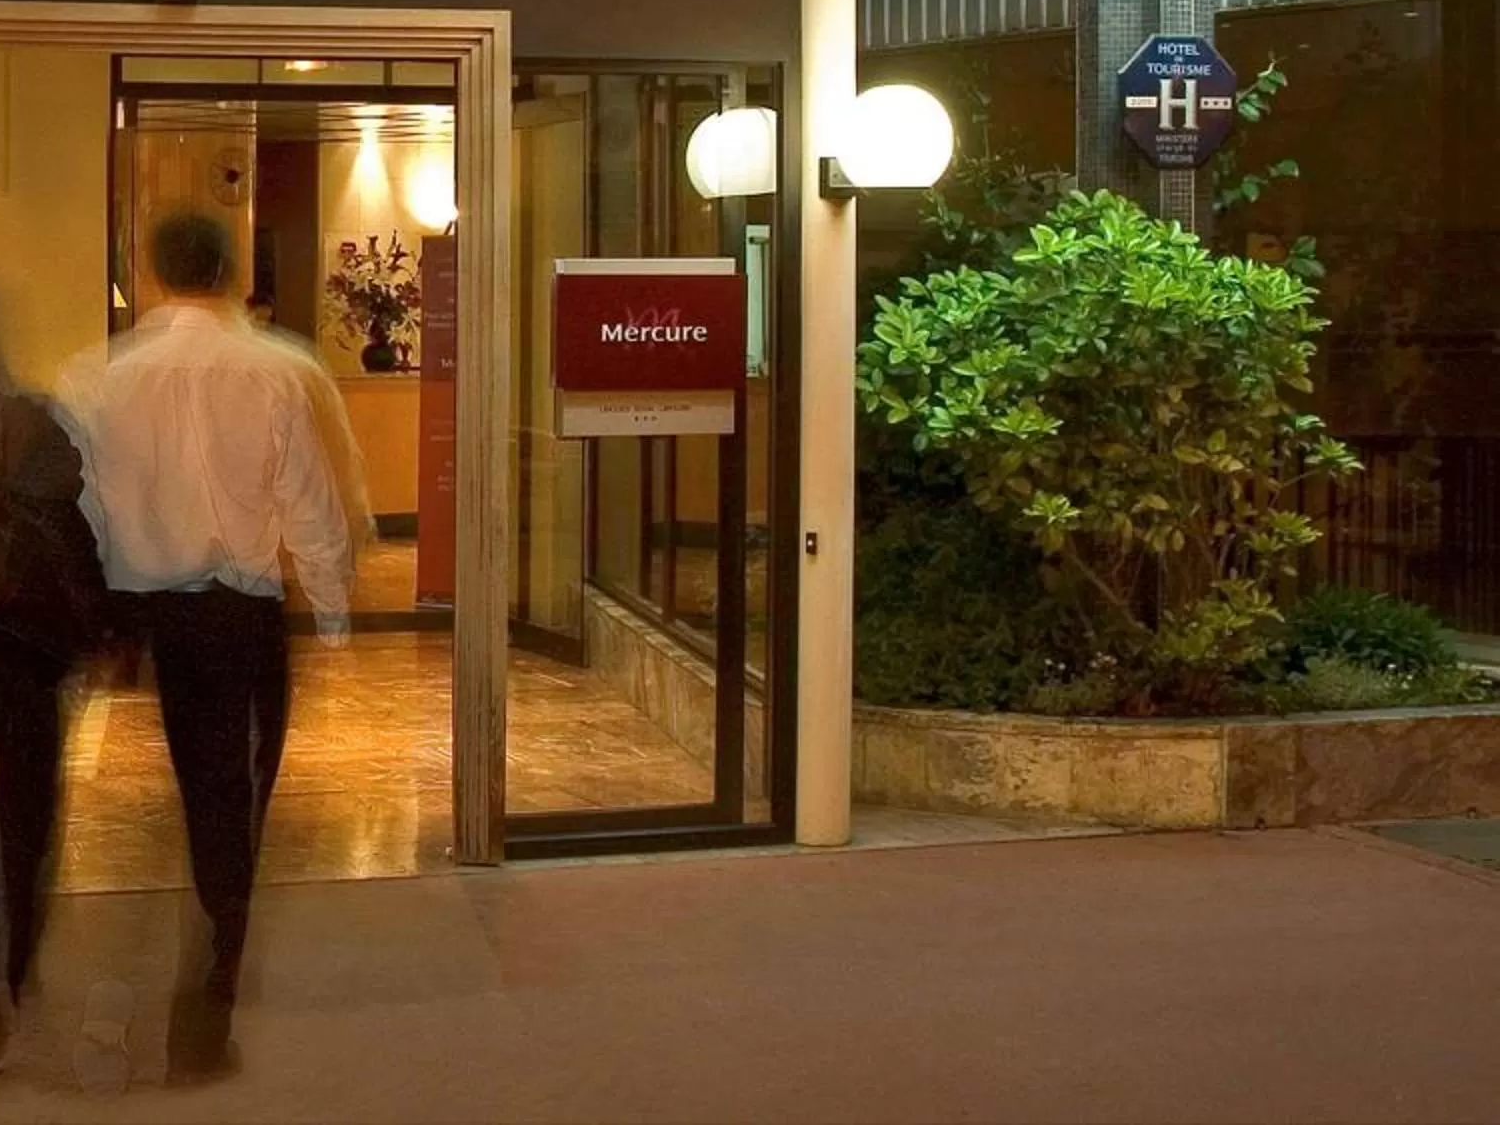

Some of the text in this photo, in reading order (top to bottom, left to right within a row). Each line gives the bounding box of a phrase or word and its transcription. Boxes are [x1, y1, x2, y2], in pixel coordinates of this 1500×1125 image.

[1157, 42, 1201, 56] HOTEL
[1146, 62, 1213, 76] TOURISME
[1158, 78, 1199, 130] H
[600, 322, 708, 343] Mercure
